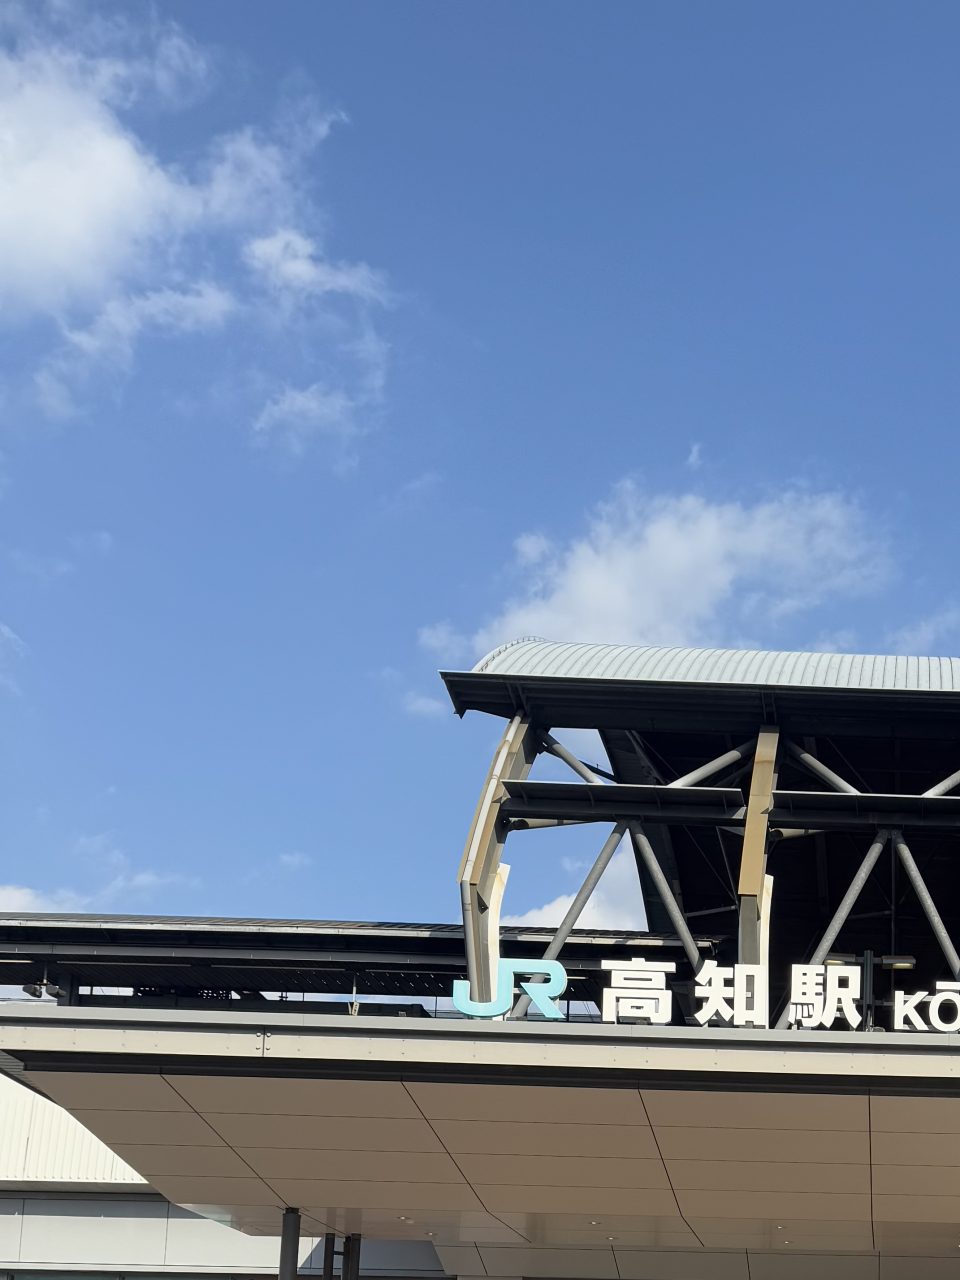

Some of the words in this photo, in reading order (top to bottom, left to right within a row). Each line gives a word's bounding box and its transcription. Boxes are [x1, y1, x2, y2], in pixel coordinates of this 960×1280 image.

[453, 957, 567, 1018] JR
[600, 957, 862, 1029] 高知駅
